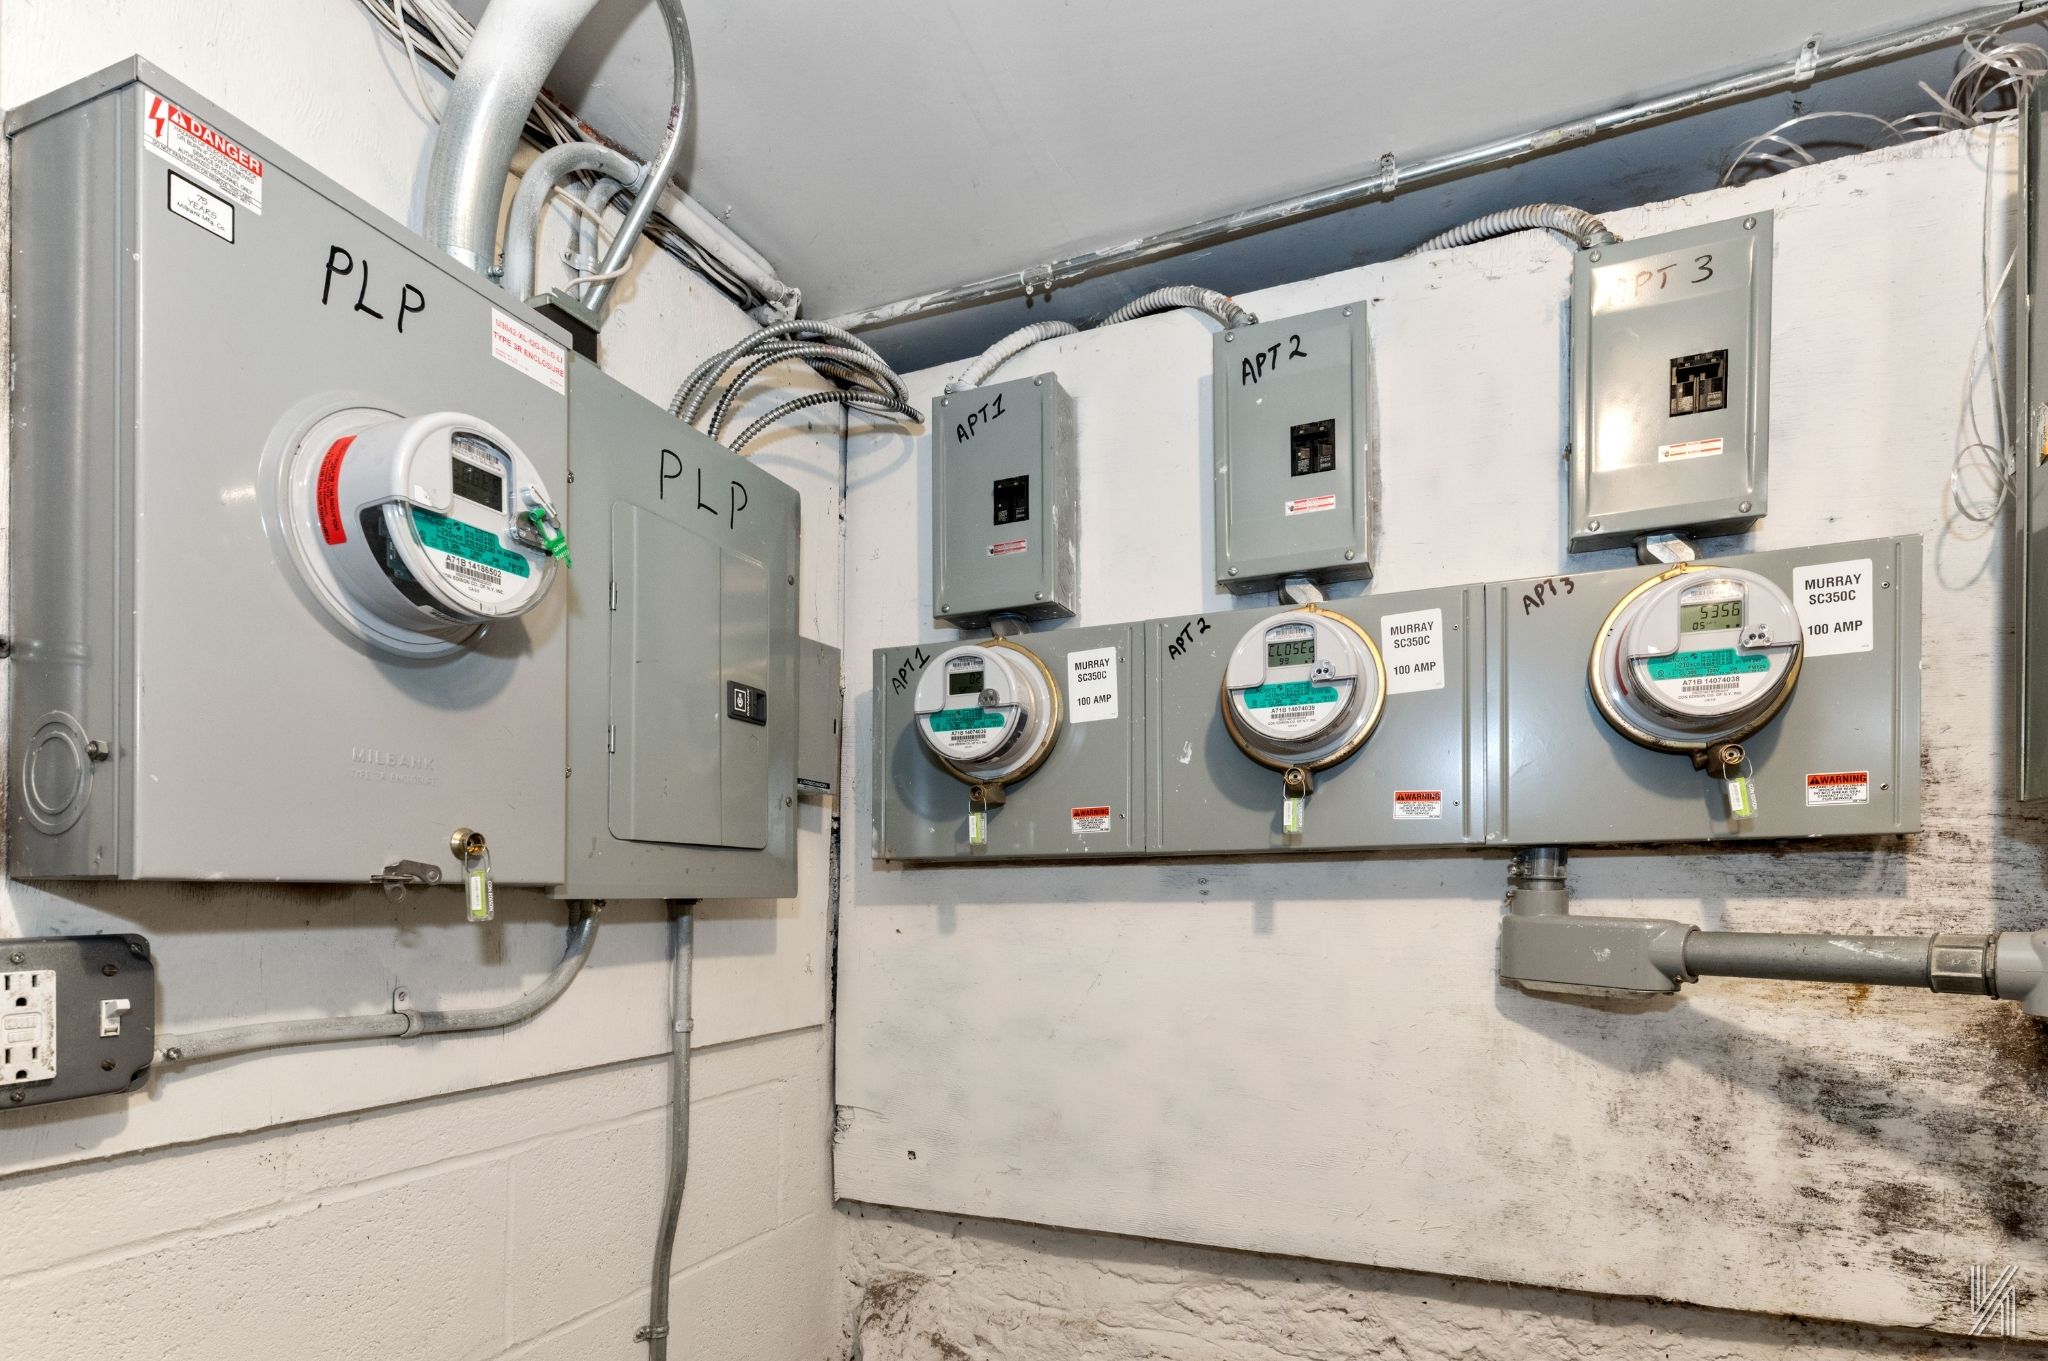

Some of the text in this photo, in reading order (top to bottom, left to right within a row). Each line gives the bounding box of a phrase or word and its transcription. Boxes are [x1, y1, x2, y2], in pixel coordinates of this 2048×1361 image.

[174, 125, 194, 141] HAZARD
[190, 121, 259, 174] DANGER
[186, 139, 202, 153] BURN
[209, 152, 227, 168] COVER
[228, 165, 254, 185] REMOVED
[192, 148, 213, 165] SERVICE
[178, 145, 210, 169] AUTHORIZED
[211, 166, 238, 187] PERSONNEL
[188, 197, 217, 219] YEARS
[197, 194, 208, 206] 75
[177, 201, 201, 217] Milbank
[1691, 255, 1714, 283] 3
[493, 331, 511, 347] TYPE
[524, 349, 564, 377] ENCLOSURE
[1242, 334, 1308, 386] APT 2
[445, 553, 503, 579] A71B 14186502
[1805, 573, 1862, 591] MURRAY
[1523, 577, 1574, 616] APT 3
[1809, 590, 1856, 605] SC350C
[1700, 602, 1741, 620] 5356
[1390, 621, 1434, 636] MURRAY
[1692, 621, 1706, 631] 05
[1807, 620, 1863, 636] 100 AMP
[1168, 617, 1211, 660] APT 2
[1394, 635, 1430, 649] SC350C
[1074, 658, 1110, 671] MURRAY
[1393, 661, 1437, 675] 100 AMP
[1077, 670, 1107, 683] SC350C
[1704, 675, 1740, 684] 14074038
[1077, 693, 1112, 706] 100 AMP
[352, 747, 435, 771] MILBANK
[1820, 774, 1867, 784] WARNING
